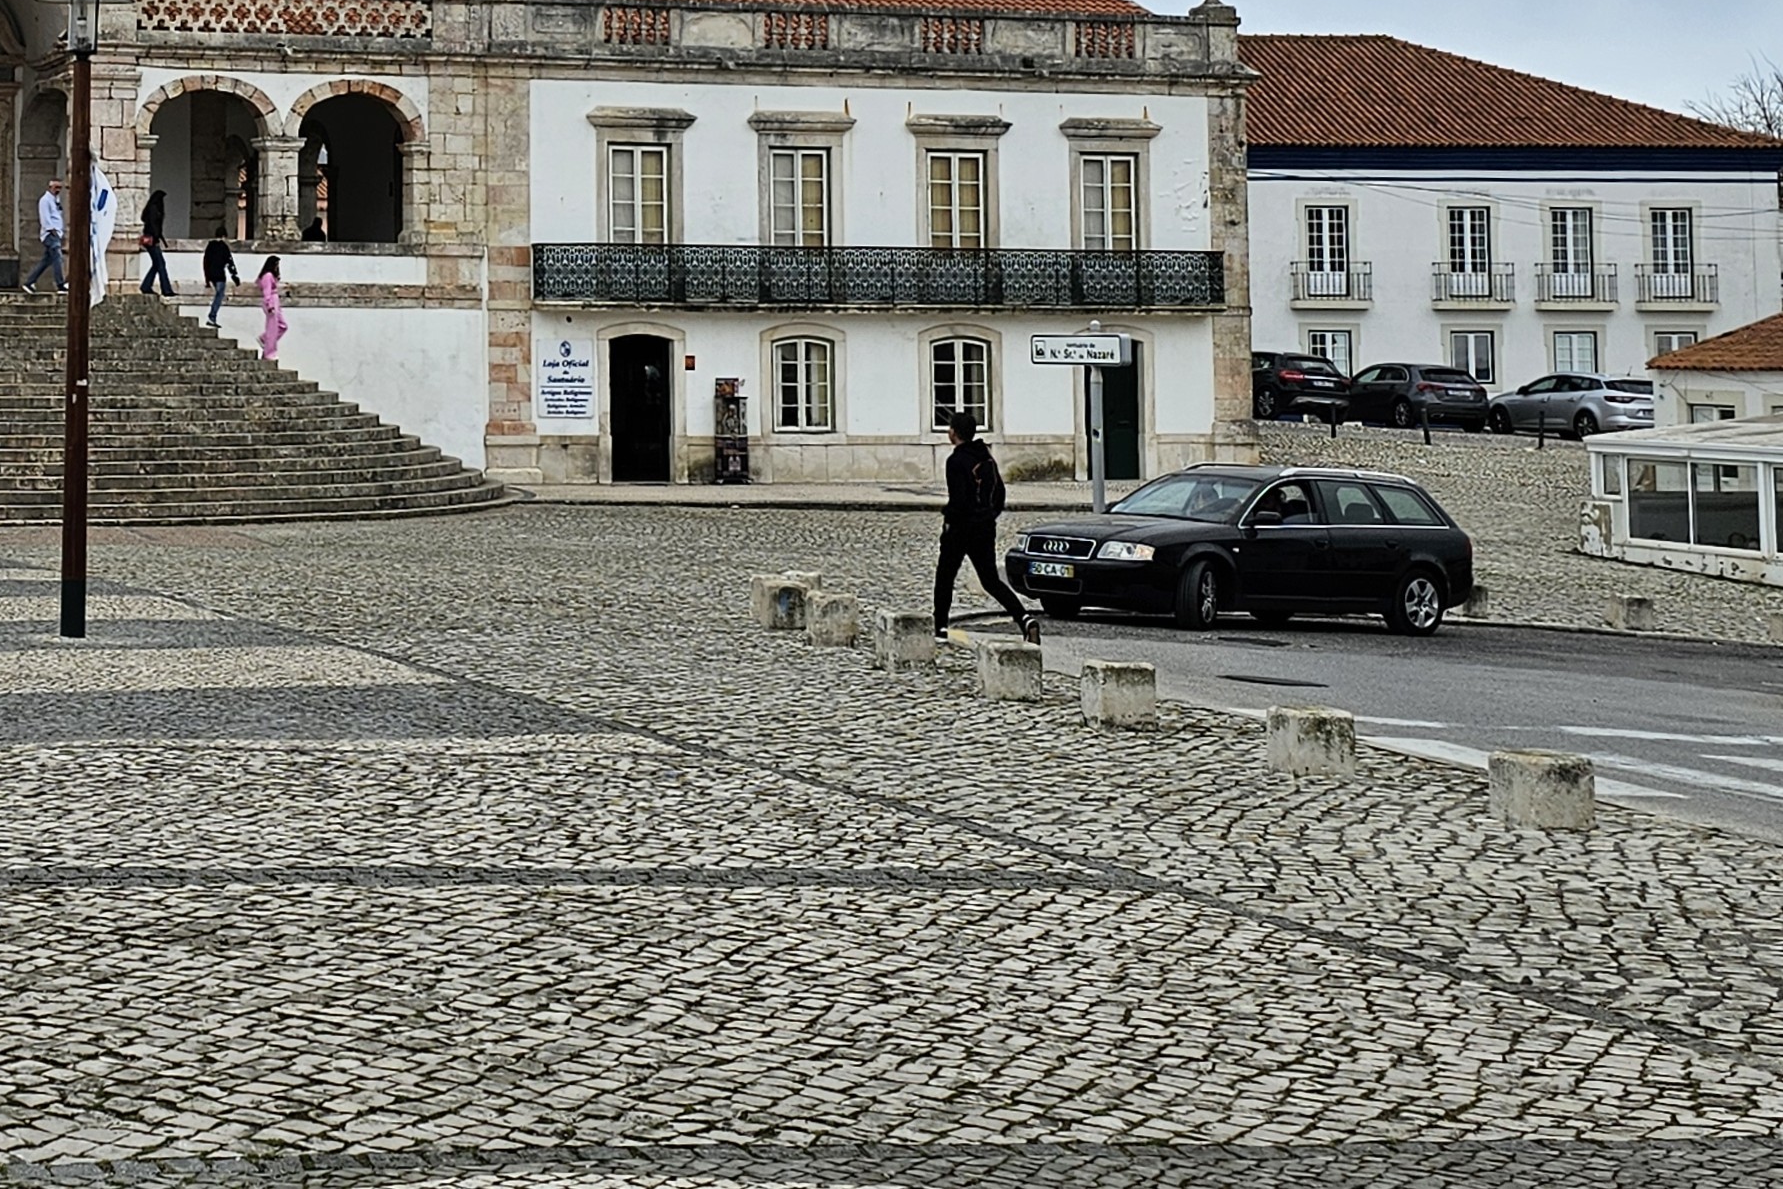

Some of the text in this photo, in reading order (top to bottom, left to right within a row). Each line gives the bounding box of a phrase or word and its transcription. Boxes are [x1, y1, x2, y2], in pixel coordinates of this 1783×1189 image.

[1087, 349, 1114, 359] Nazaré
[543, 360, 589, 368] Loja Oficial
